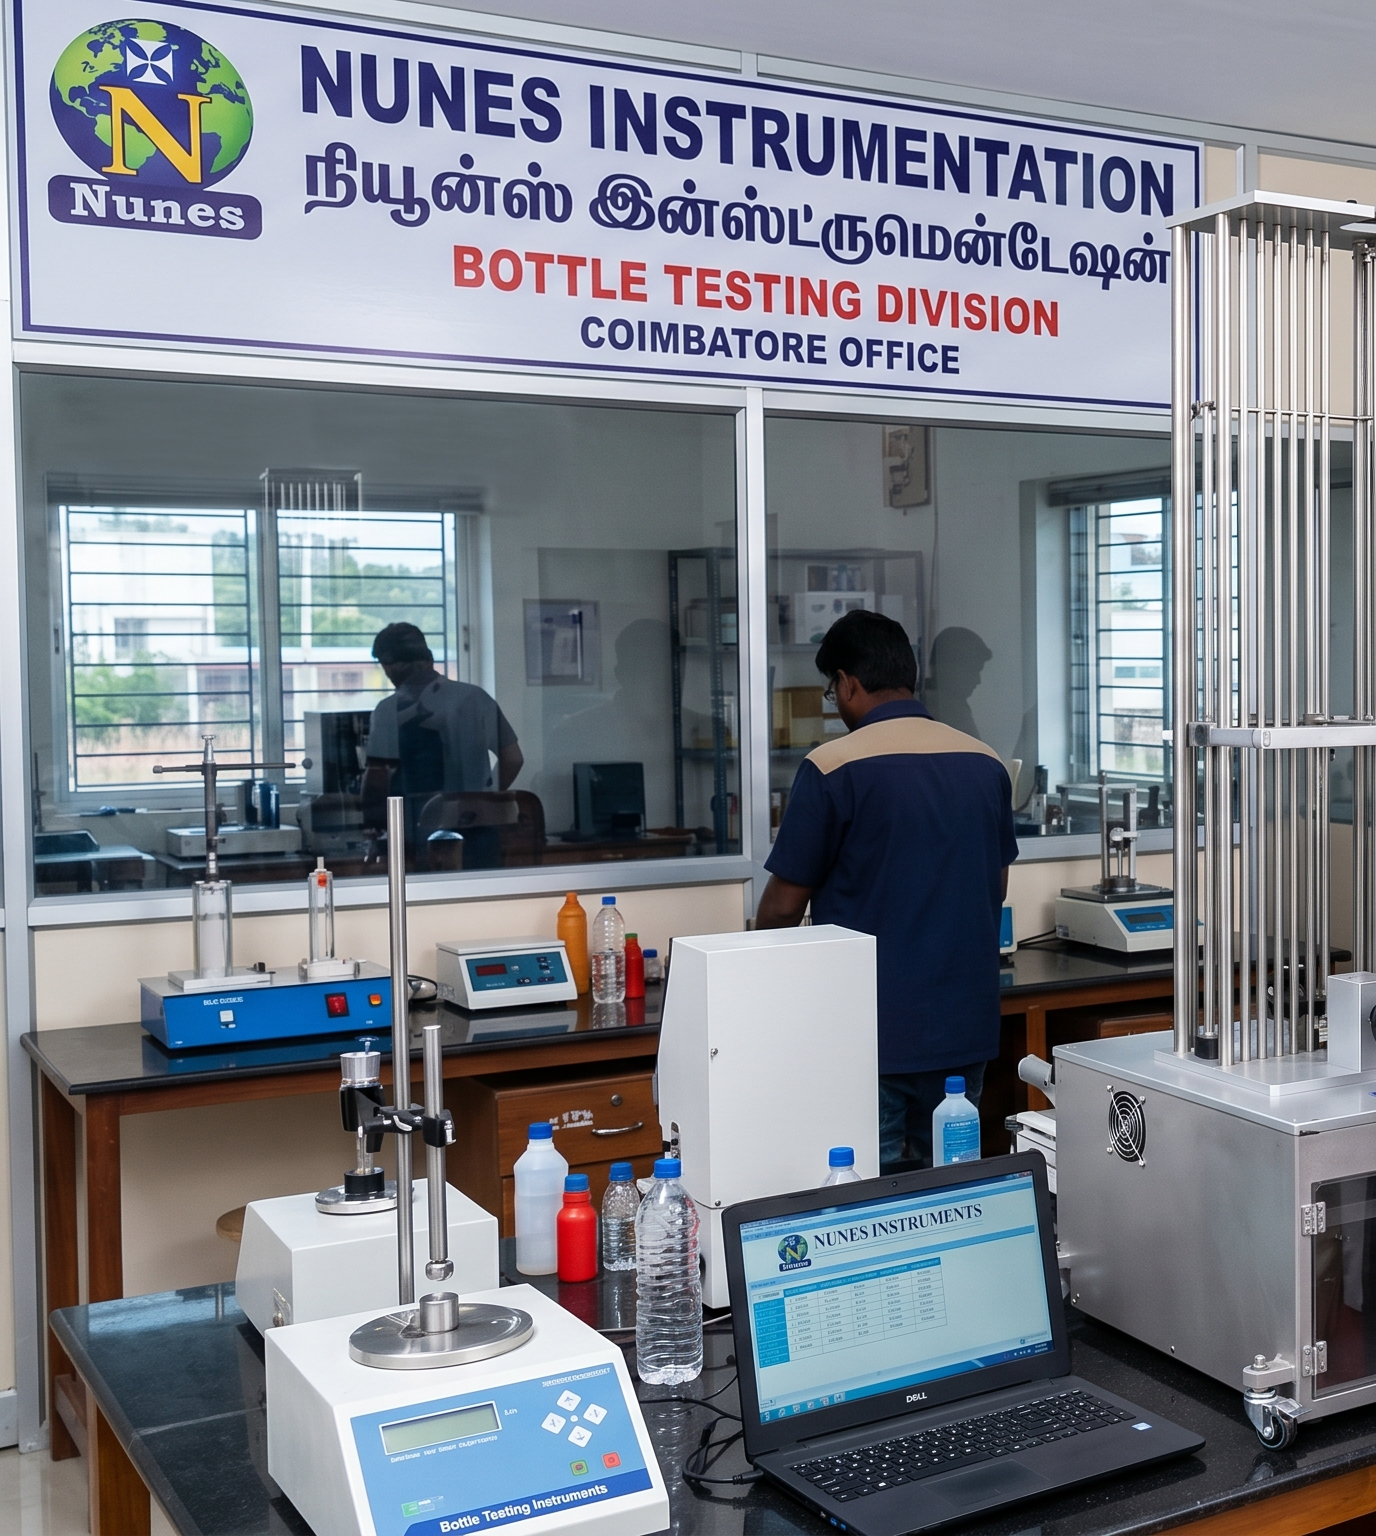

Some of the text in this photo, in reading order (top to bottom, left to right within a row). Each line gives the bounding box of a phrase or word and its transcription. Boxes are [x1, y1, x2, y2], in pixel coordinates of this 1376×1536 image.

[301, 45, 1174, 218] NUNES INSTRUMENTATION
[69, 182, 246, 231] Nunes
[304, 141, 1171, 291] நியூன்ஸ் இன்ஸ்ட்ருமென்டேஷன்
[453, 245, 1059, 337] BOTTLE TESTING DIVISION
[580, 316, 960, 375] COIMBATORE OFFICE
[813, 1225, 869, 1250] NUNES
[872, 1204, 983, 1238] INSTRUMENTS
[906, 1391, 928, 1404] DELL
[439, 1485, 608, 1533] Bottle Testing Instruments
